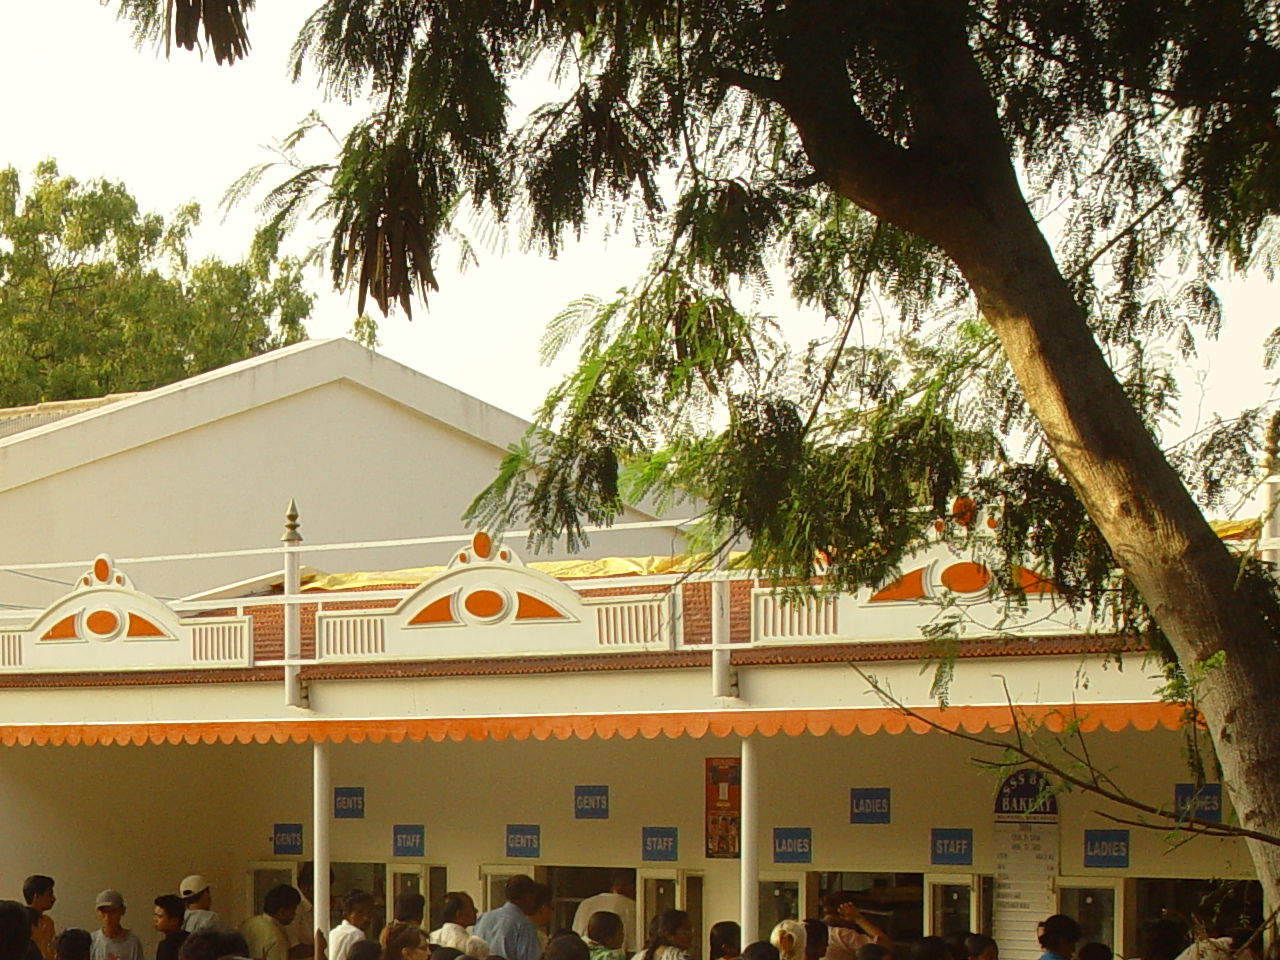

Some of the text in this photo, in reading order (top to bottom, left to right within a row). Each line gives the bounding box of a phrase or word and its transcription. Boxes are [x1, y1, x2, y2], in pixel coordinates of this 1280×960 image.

[336, 797, 363, 809] GENTS
[577, 795, 607, 809] GENTS
[853, 798, 888, 813] LADIES
[1178, 795, 1219, 811] LES
[275, 834, 302, 846] GENTS
[396, 834, 421, 847] STAFF
[508, 835, 538, 849] GENTS
[645, 837, 674, 850] STAFF
[775, 838, 810, 853] LADIES
[935, 839, 968, 854] STAFF
[1086, 841, 1127, 857] LADIES
